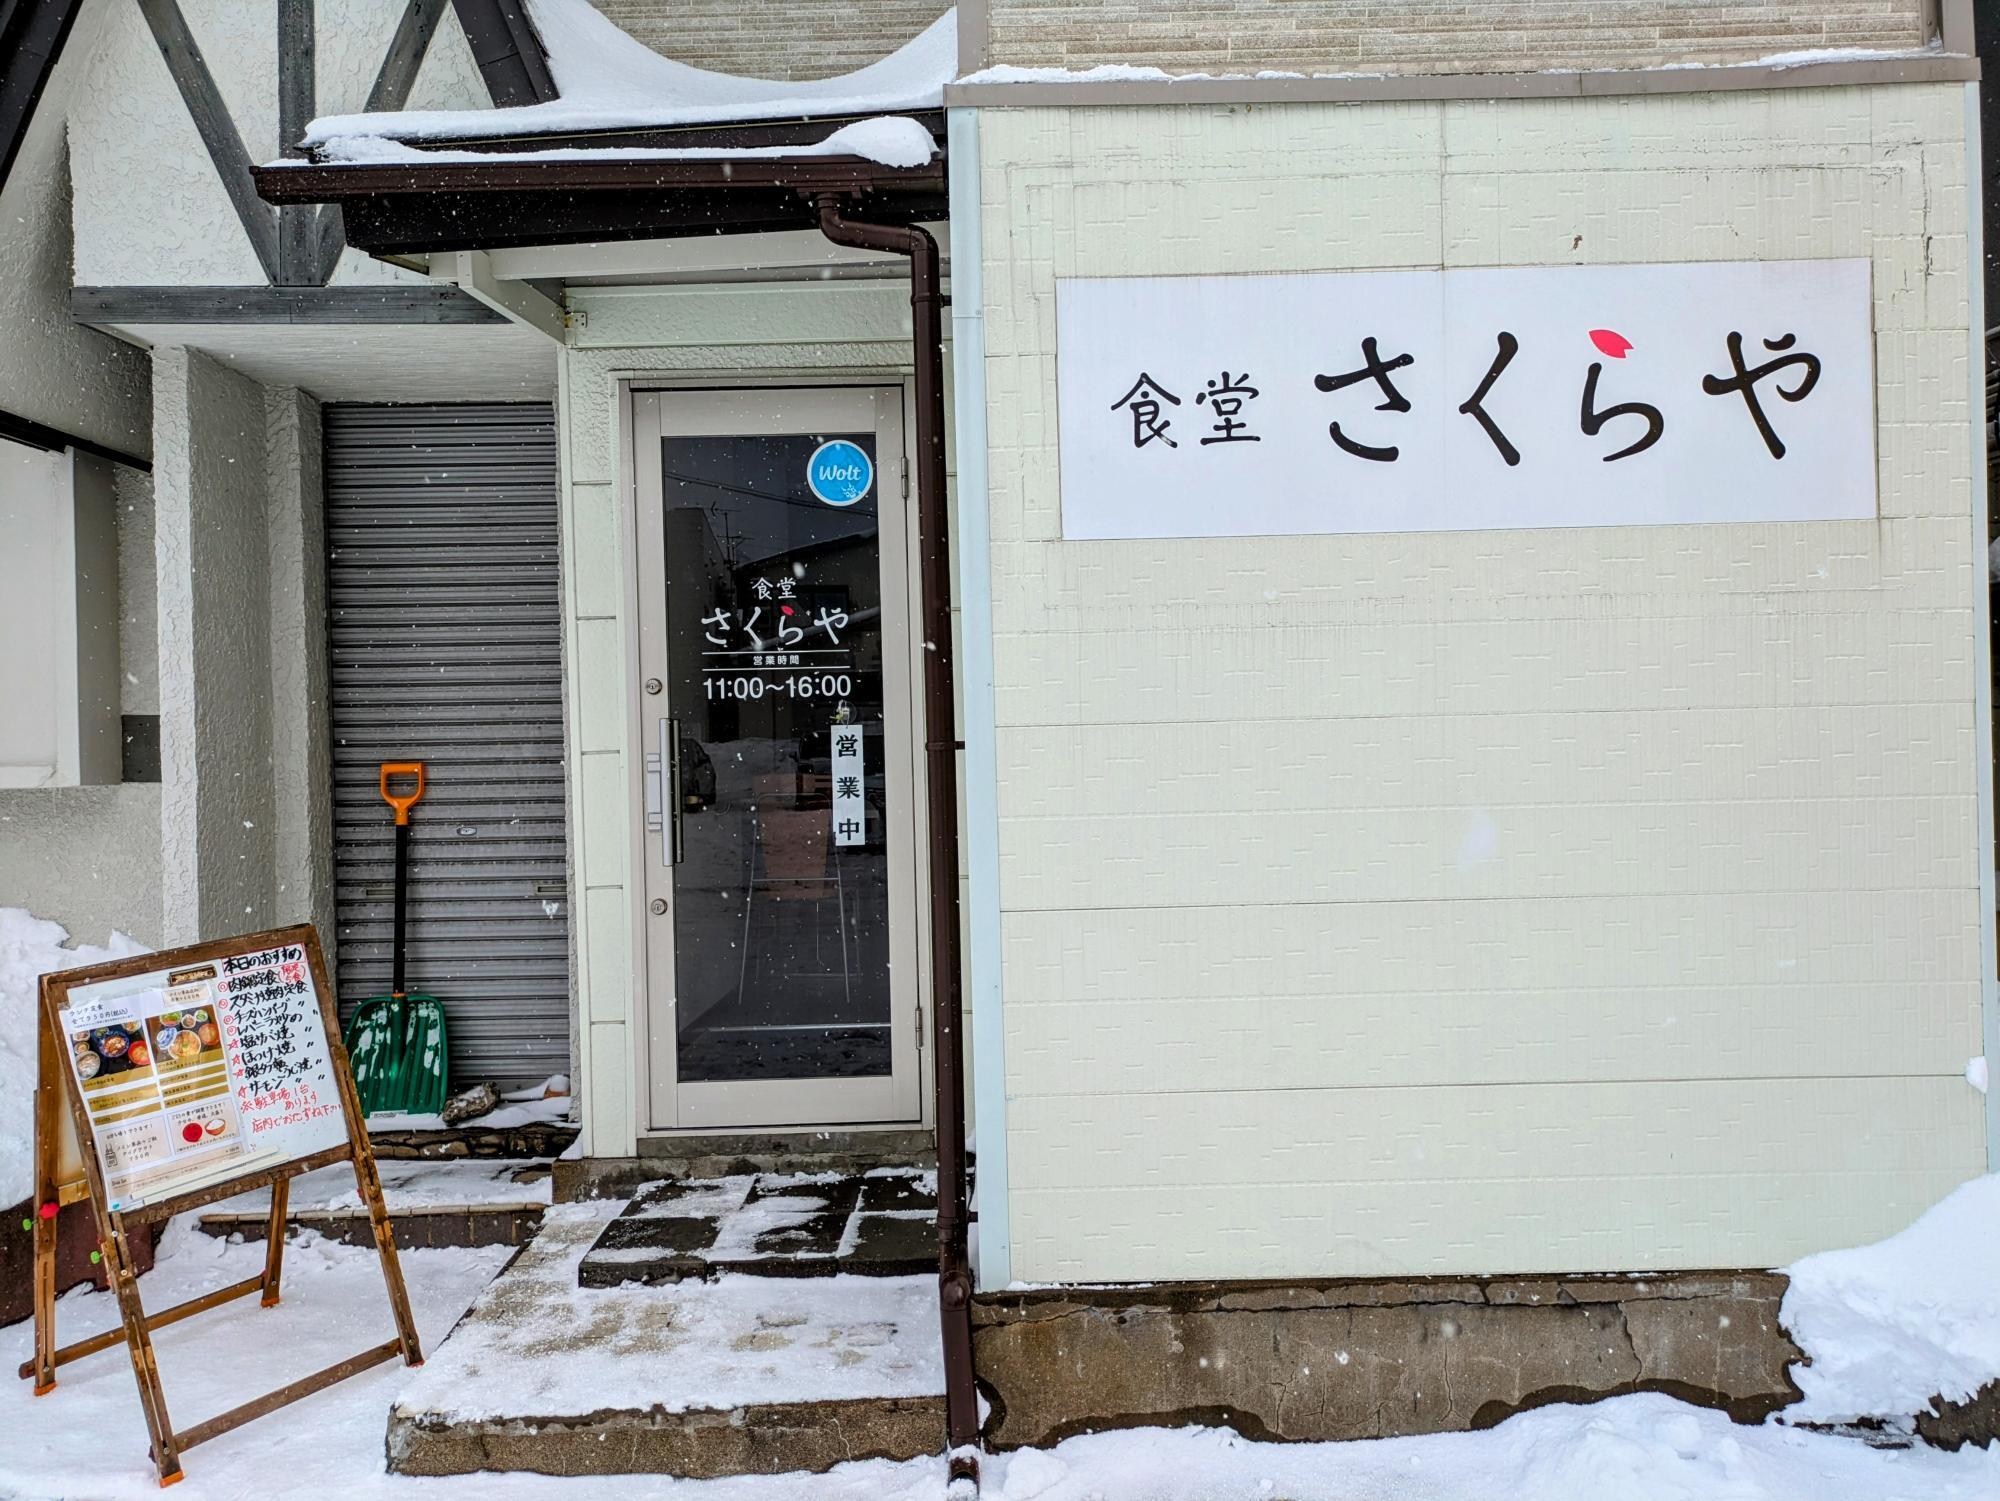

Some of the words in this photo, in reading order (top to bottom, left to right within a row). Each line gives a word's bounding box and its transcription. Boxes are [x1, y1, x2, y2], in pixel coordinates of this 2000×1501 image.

[1110, 371, 1261, 449] 食堂
[1314, 330, 1822, 467] さくらや
[819, 465, 861, 481] Wolt
[752, 576, 797, 600] 食堂
[701, 606, 850, 649] さくらや
[753, 654, 800, 665] 営業時間
[835, 734, 861, 841] 営業中
[224, 947, 302, 974] 本日のおすすめ
